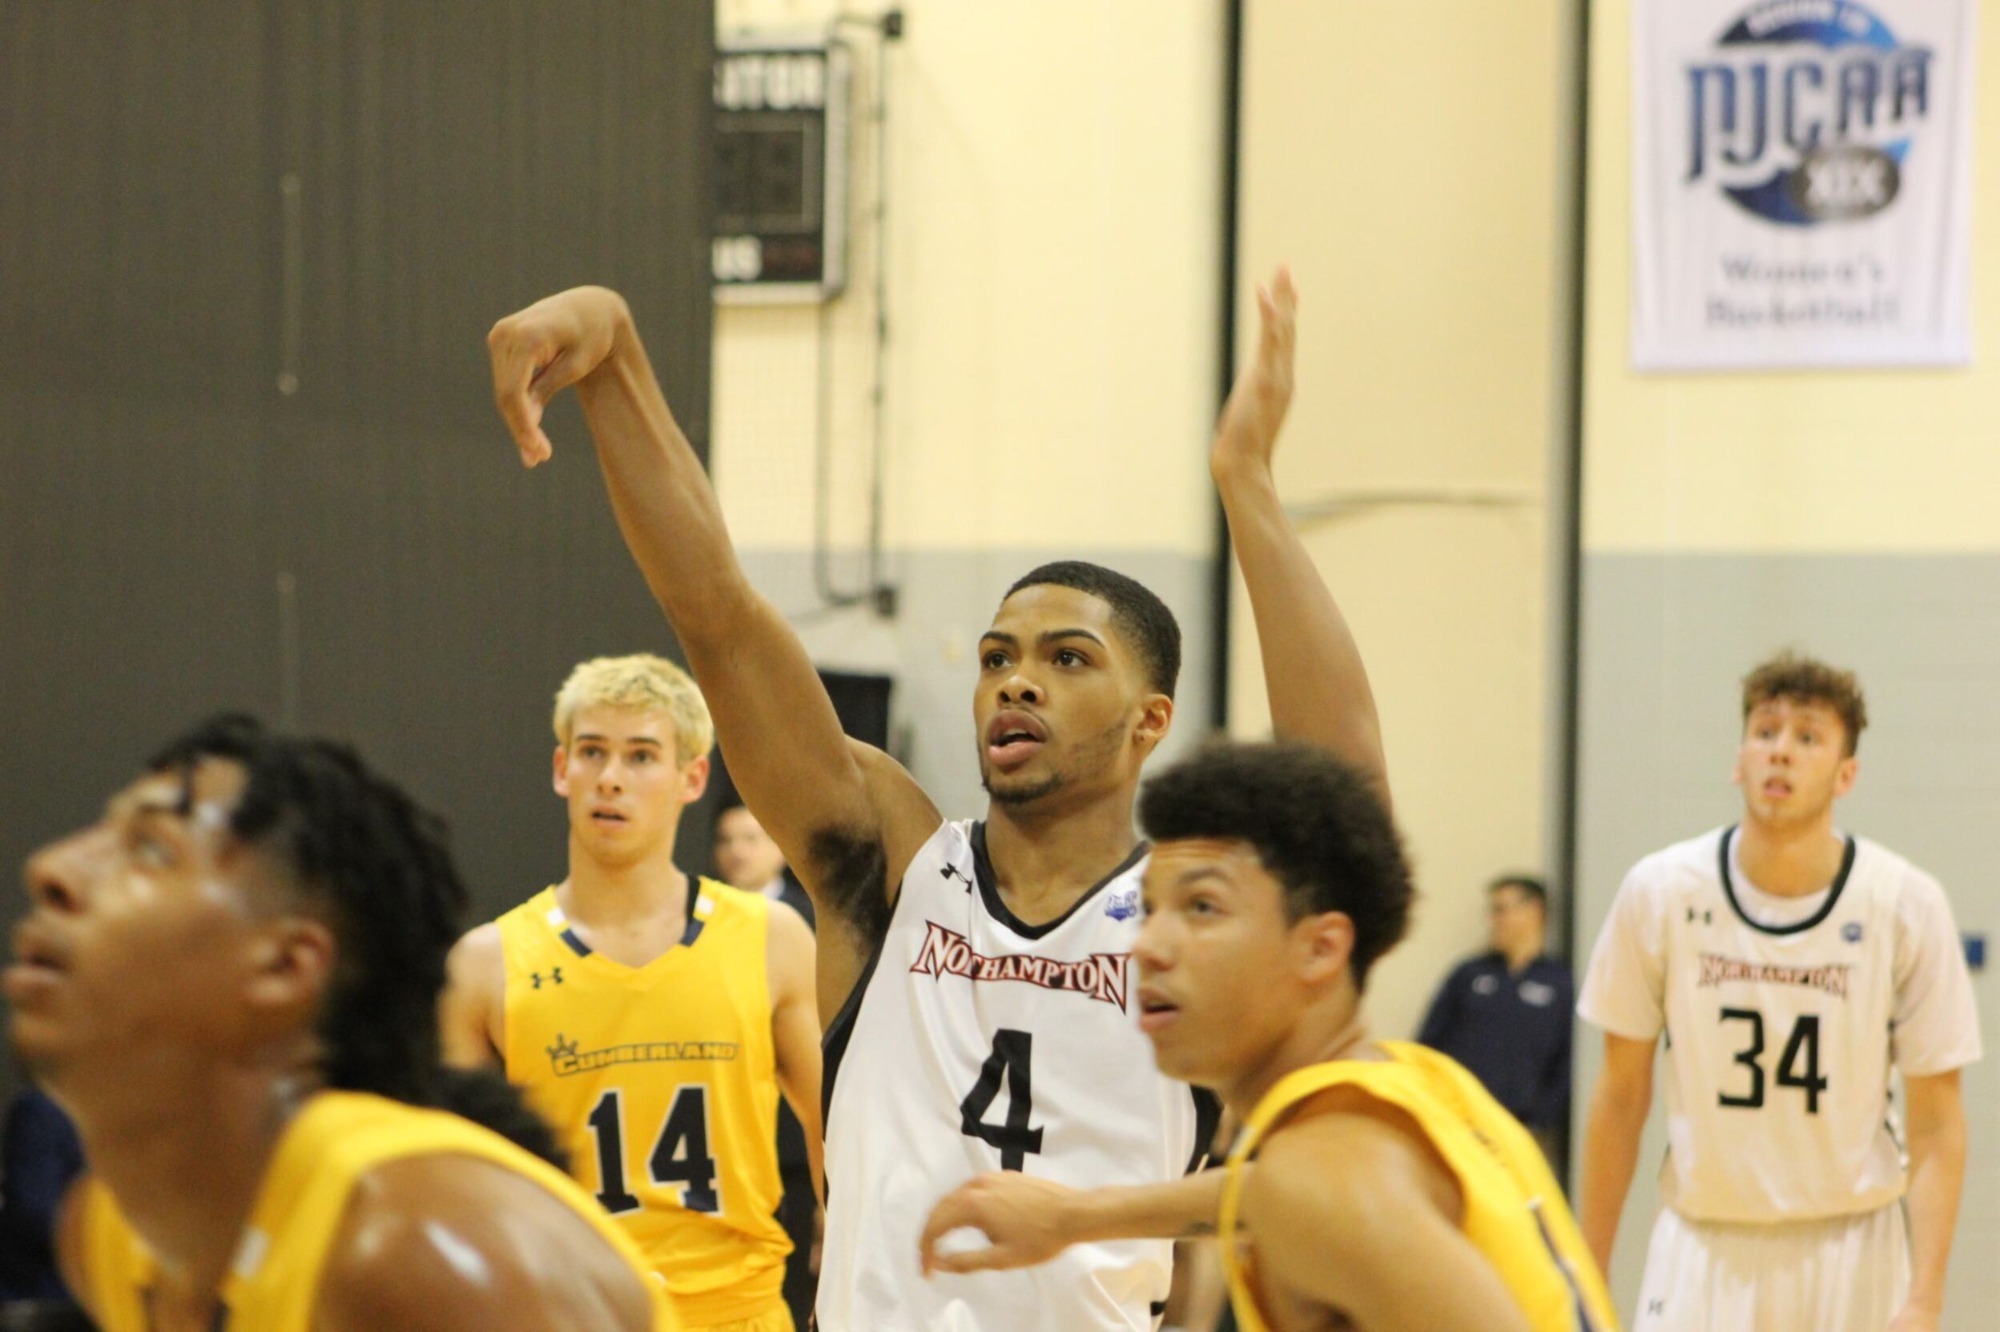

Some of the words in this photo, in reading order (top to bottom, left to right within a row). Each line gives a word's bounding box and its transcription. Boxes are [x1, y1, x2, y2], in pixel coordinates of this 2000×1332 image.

[713, 57, 824, 110] ITOR
[1684, 47, 1933, 182] NJCAA
[960, 1027, 1044, 1172] 4
[1717, 1008, 1828, 1114] 34
[586, 1082, 724, 1217] 14
